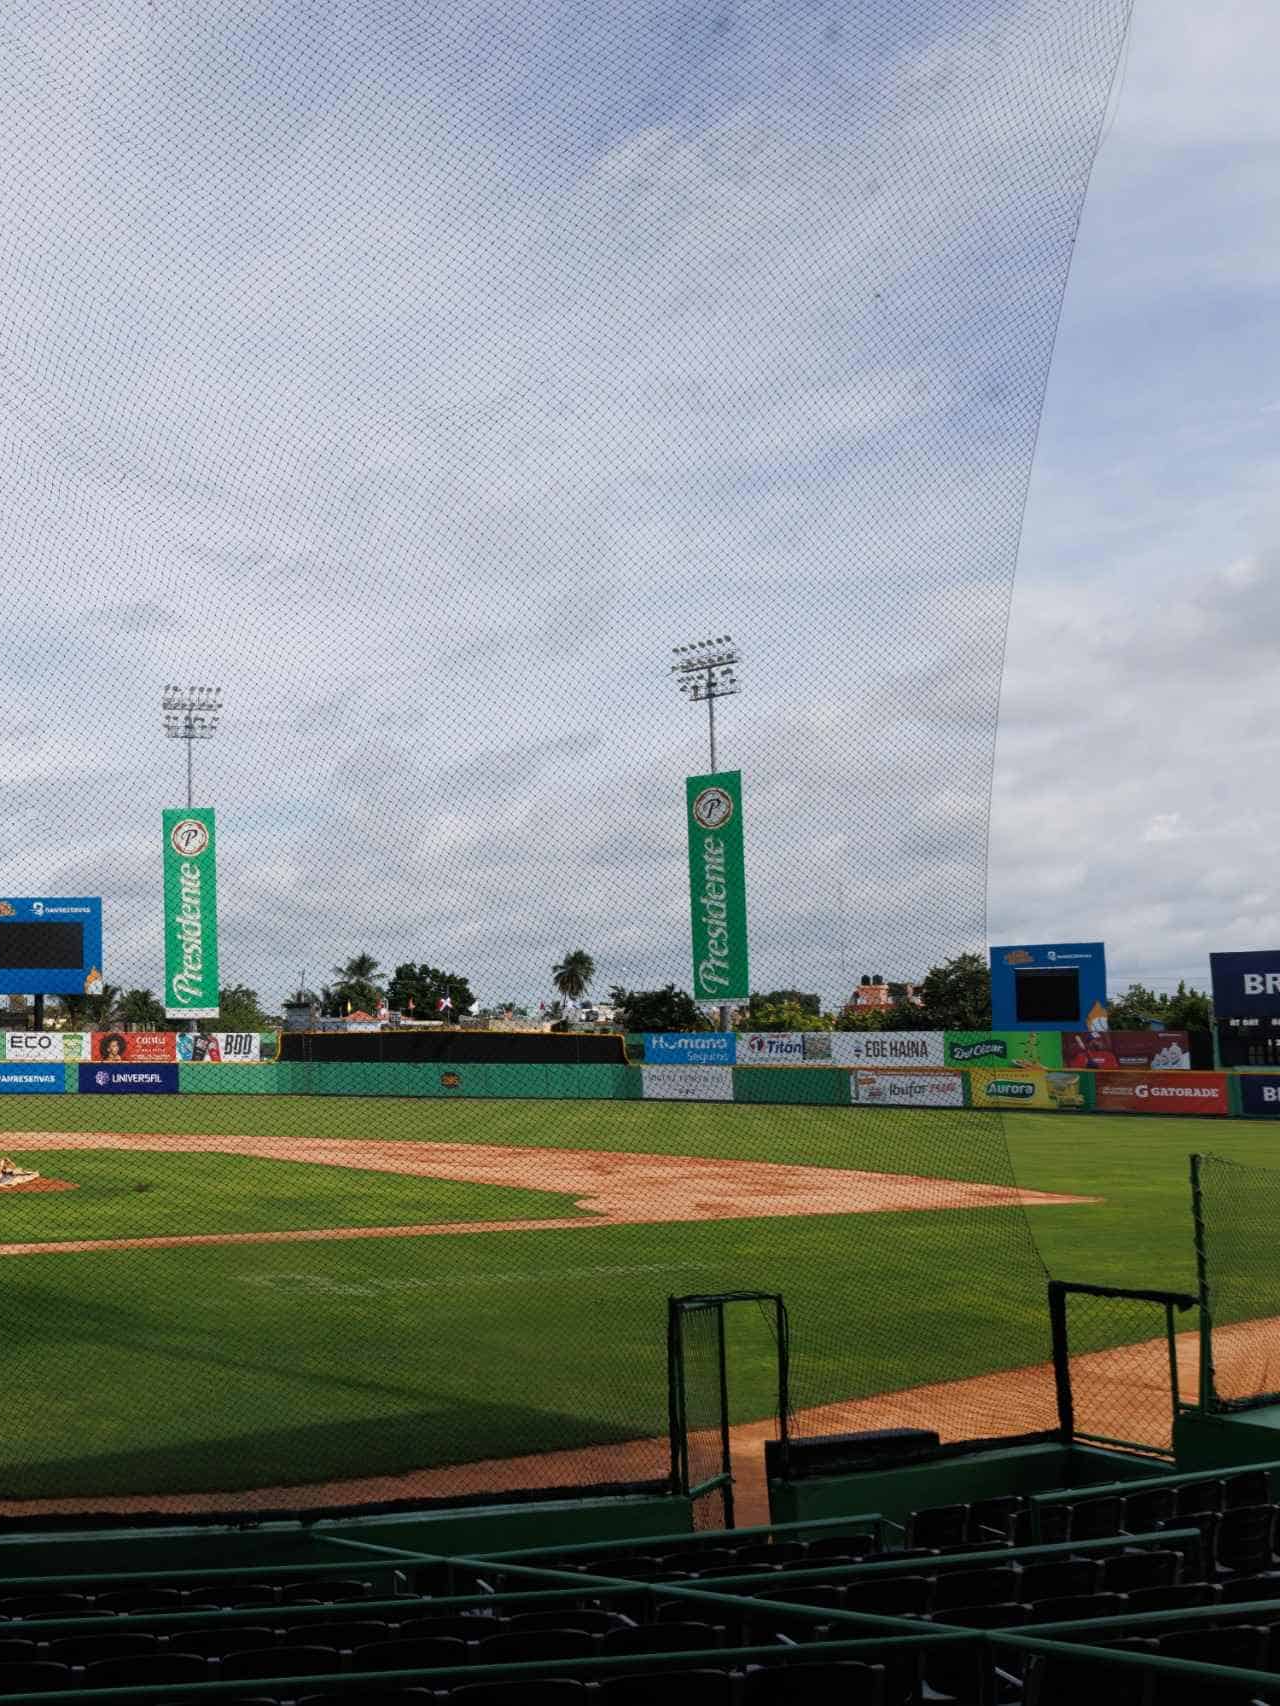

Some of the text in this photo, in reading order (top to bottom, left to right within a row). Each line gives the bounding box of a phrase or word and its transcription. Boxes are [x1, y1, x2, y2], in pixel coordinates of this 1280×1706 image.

[698, 836, 730, 995] Presidente
[172, 862, 204, 1005] Presidente
[10, 1035, 52, 1049] ECO
[866, 1041, 888, 1058] EGE
[987, 1083, 1034, 1096] Aurora
[1150, 1087, 1220, 1098] GATORADE
